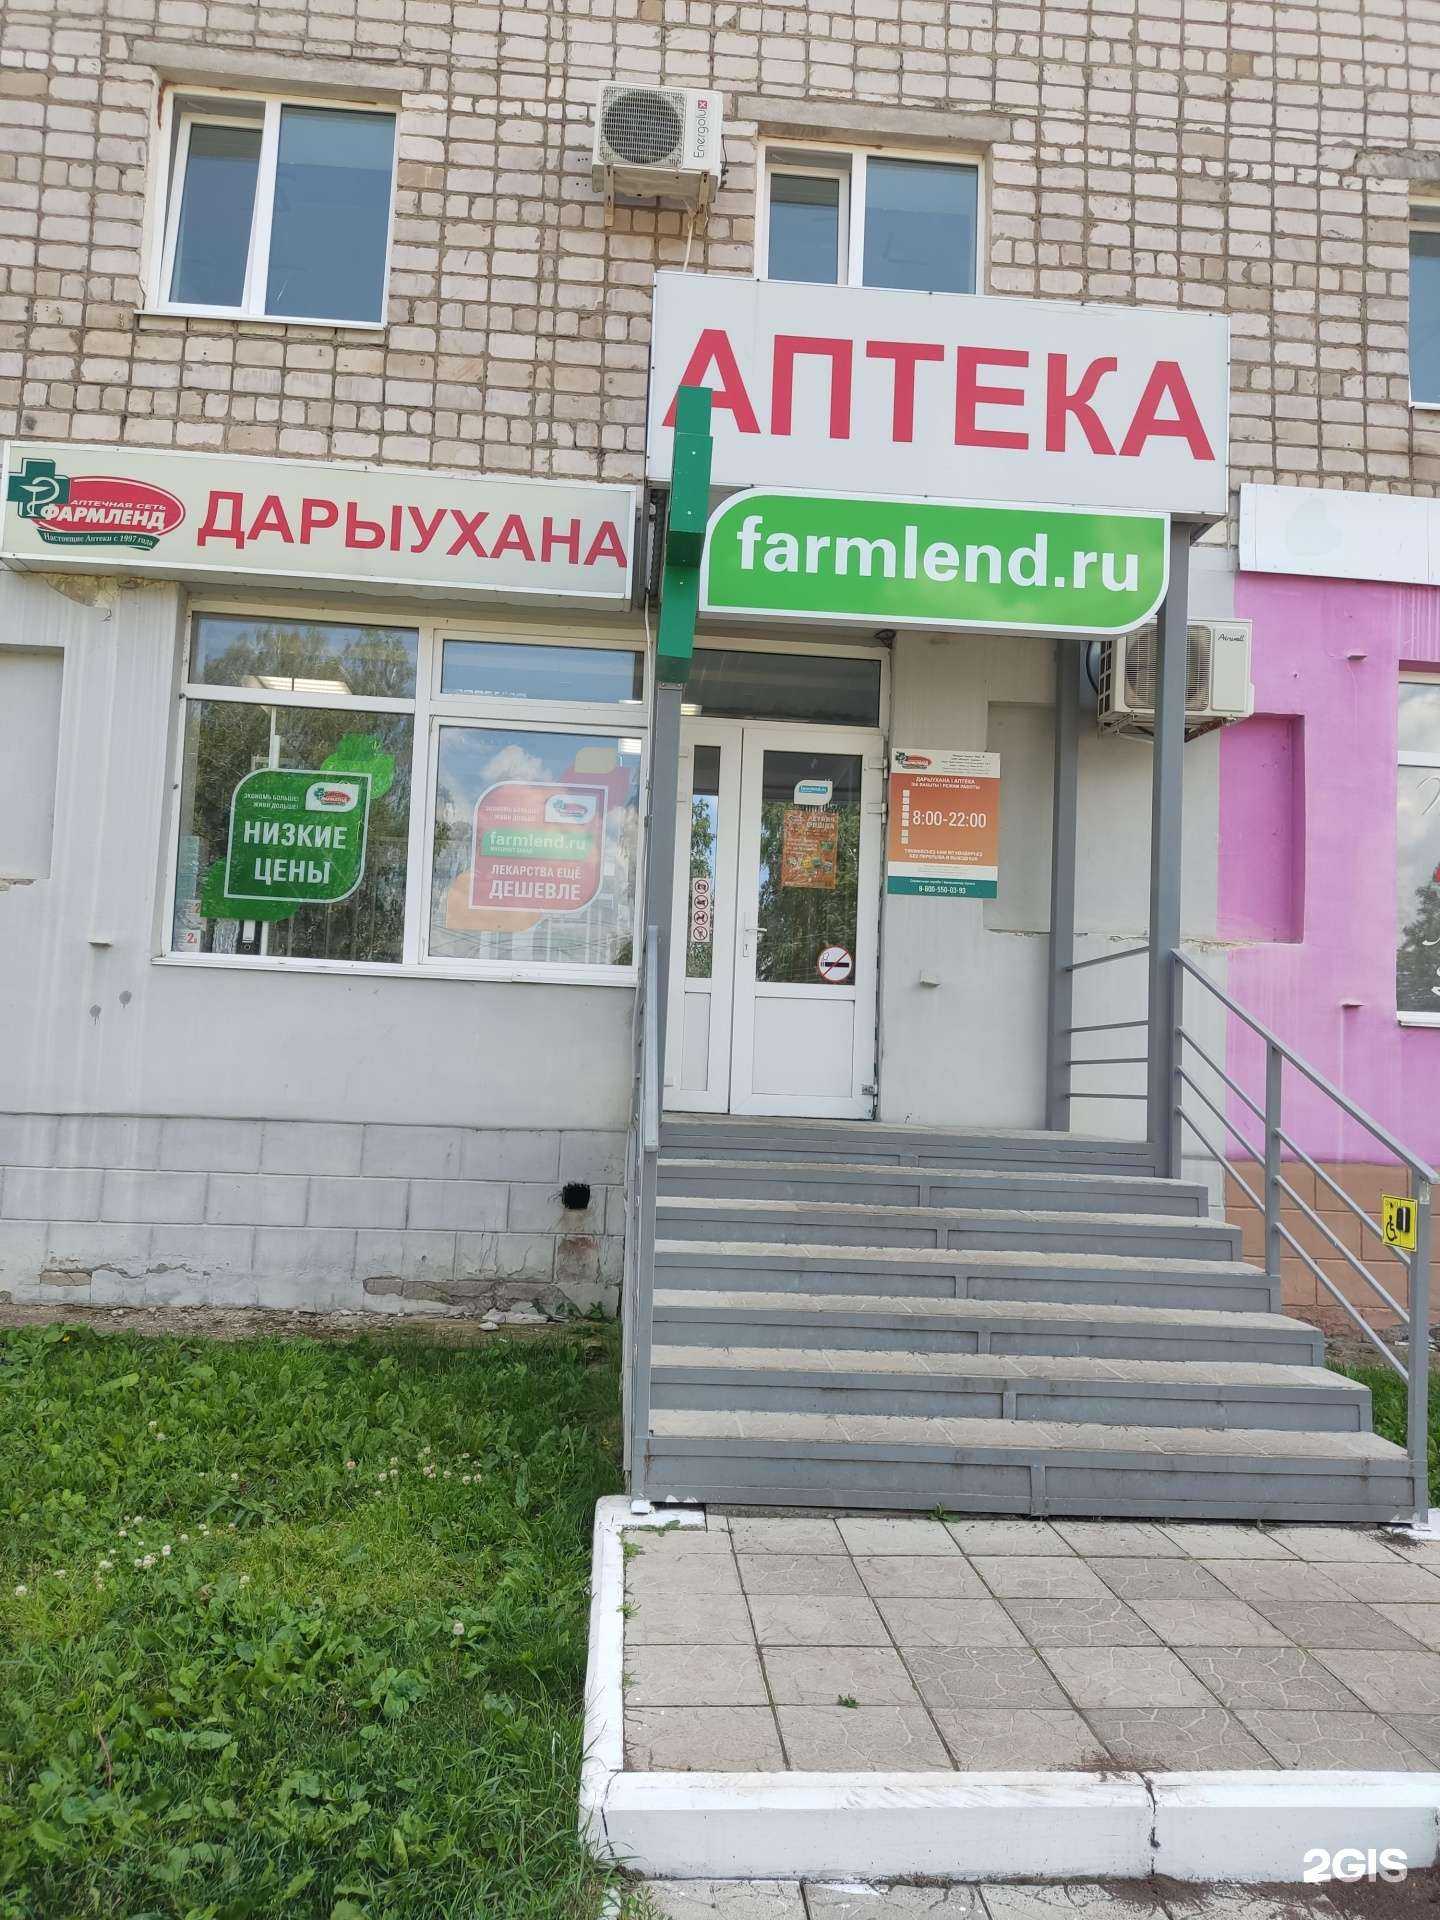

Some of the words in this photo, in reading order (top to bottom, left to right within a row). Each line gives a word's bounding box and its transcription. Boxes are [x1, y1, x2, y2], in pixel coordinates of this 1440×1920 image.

[693, 99, 709, 158] Energolux
[661, 328, 1216, 461] АПТЕКА
[40, 504, 165, 530] ФАРМЛЕНД
[71, 499, 133, 508] АПТЕЧНАЯ
[136, 503, 167, 511] СЕТЬ
[120, 534, 137, 543] 1997
[197, 490, 628, 568] ДАРЫУХАНА
[735, 515, 1139, 592] farmlend.ru
[912, 810, 987, 828] 8:00-22:00
[243, 820, 348, 849] НИЗКИЕ
[489, 831, 587, 850] farmlend.ru
[254, 857, 332, 885] ЦЕНЫ
[490, 864, 554, 877] ЛЕКАРСТВА
[488, 879, 581, 900] ДЕШЕВЛЕ
